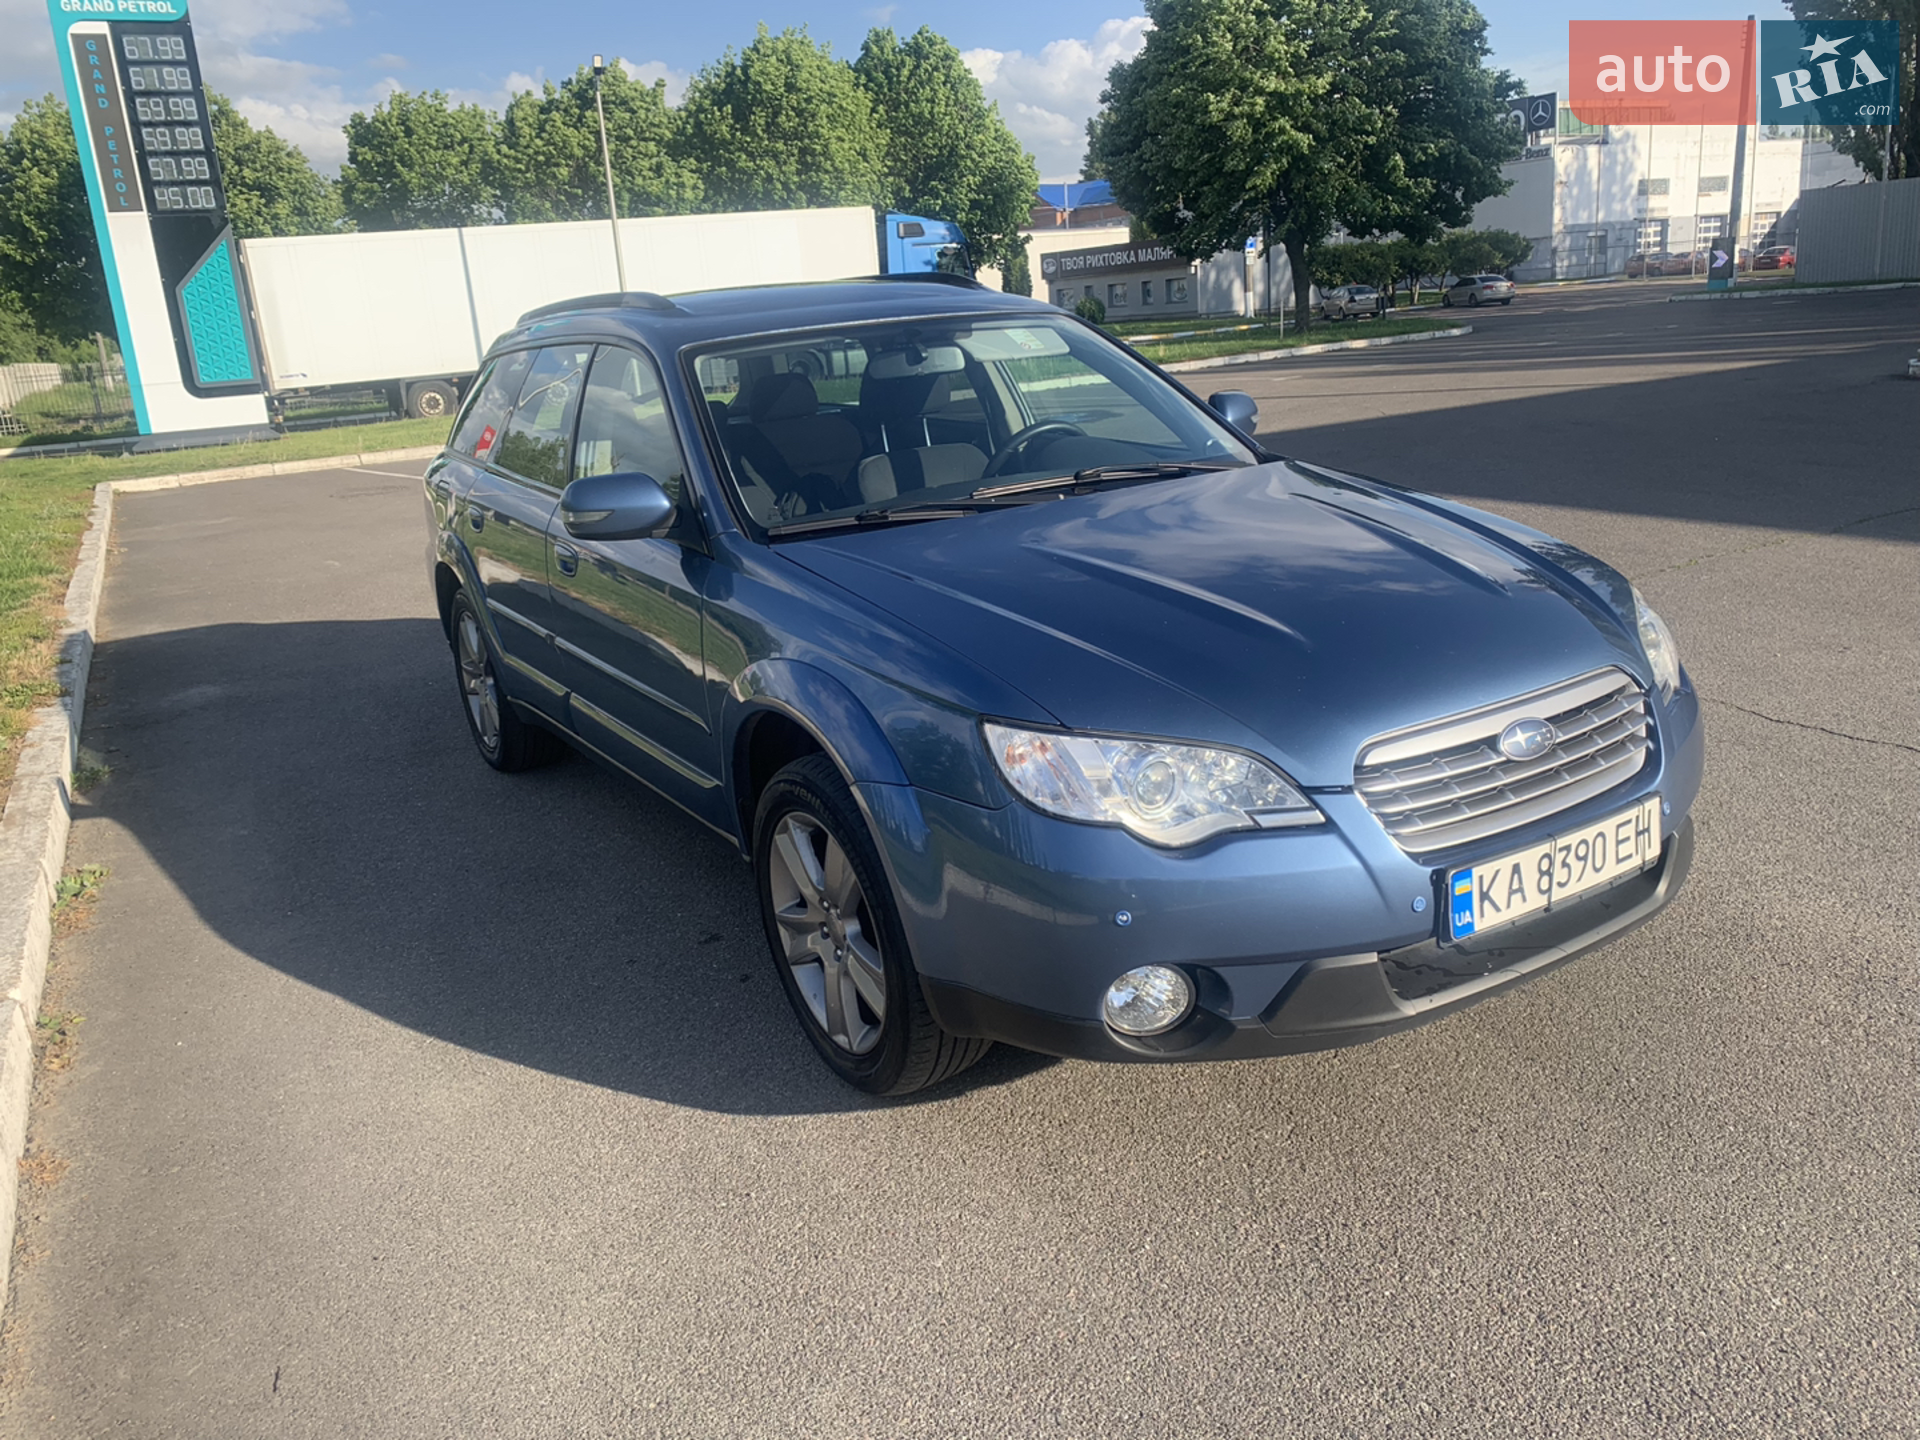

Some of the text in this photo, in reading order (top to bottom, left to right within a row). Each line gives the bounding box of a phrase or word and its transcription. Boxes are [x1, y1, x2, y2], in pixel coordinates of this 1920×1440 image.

[60, 0, 177, 13] GRAND PETROL
[122, 36, 187, 60] 67.99
[129, 67, 192, 90] 61.99
[135, 98, 199, 120] 59.99
[85, 40, 128, 206] GRAND PETROL
[142, 128, 204, 150] 59.99
[148, 157, 210, 180] 57.99
[154, 186, 216, 209] 45.00
[1061, 246, 1177, 271] ТВОЯ РИХТОВКА МАЛЯР
[1478, 808, 1652, 919] KA 8390 EH
[1454, 910, 1473, 927] UA
